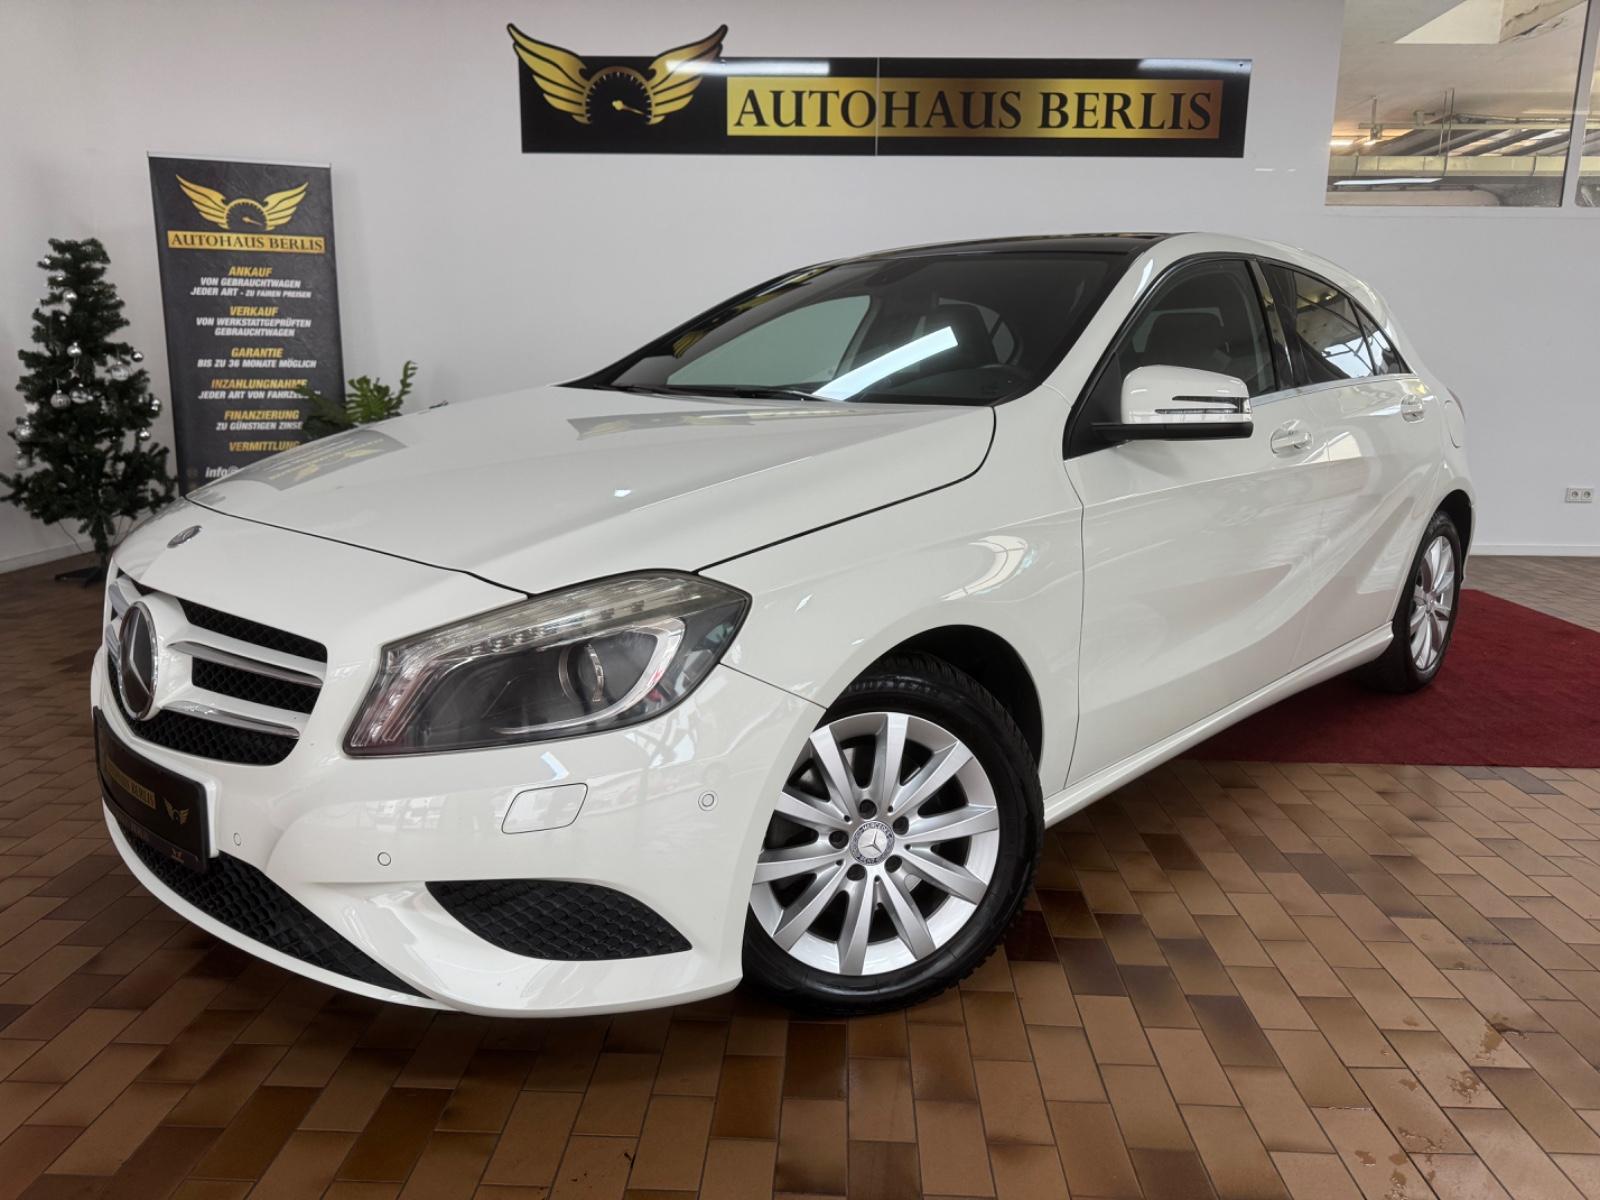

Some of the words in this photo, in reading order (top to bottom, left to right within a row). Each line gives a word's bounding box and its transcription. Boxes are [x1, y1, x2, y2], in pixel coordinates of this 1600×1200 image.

[732, 88, 1022, 130] AUTOHAUS
[1037, 91, 1212, 130] BERLIS
[171, 233, 265, 249] AUTOHAUS
[269, 236, 323, 251] BERLIS
[228, 266, 273, 277] ANKAUF
[200, 277, 219, 286] VON
[221, 277, 301, 288] GEBRAUCHTWAGEN
[190, 287, 219, 296] JEDER
[220, 287, 239, 296] ART
[229, 306, 279, 316] VERKAUF
[196, 317, 215, 326] VON
[216, 317, 312, 328] WERKSTATTGEPRÜFTEN
[214, 327, 296, 337] GEBRAUCHTWAGEN
[231, 347, 284, 358] GARANTIE
[197, 358, 212, 368] BIS
[214, 359, 226, 368] ZU
[228, 359, 240, 368] 36
[242, 359, 277, 368] MONATE
[278, 358, 317, 368] MÖGLICH
[198, 390, 226, 399] JEDER
[227, 390, 245, 399] ART
[247, 390, 266, 399] VON
[224, 410, 300, 420] FINANZIERUNG
[216, 422, 228, 431] ZU
[229, 421, 278, 431] GÜNSTIGEN
[279, 421, 303, 431] ZINSE
